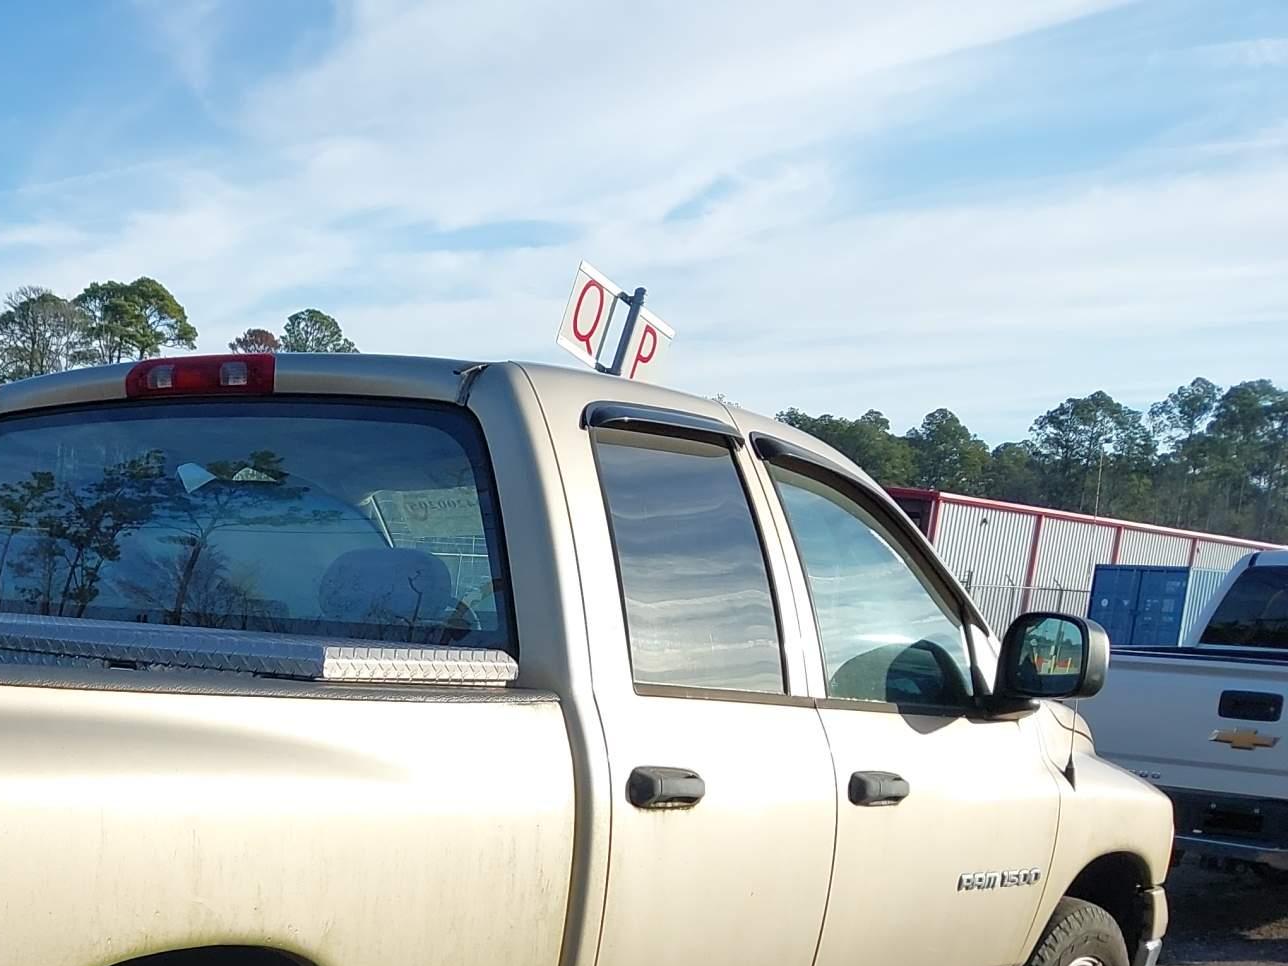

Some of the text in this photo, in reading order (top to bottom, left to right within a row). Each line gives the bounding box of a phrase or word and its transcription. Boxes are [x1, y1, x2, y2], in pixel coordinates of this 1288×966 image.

[573, 278, 604, 356] Q
[629, 323, 657, 380] P
[957, 867, 1041, 892] RAM 1500
